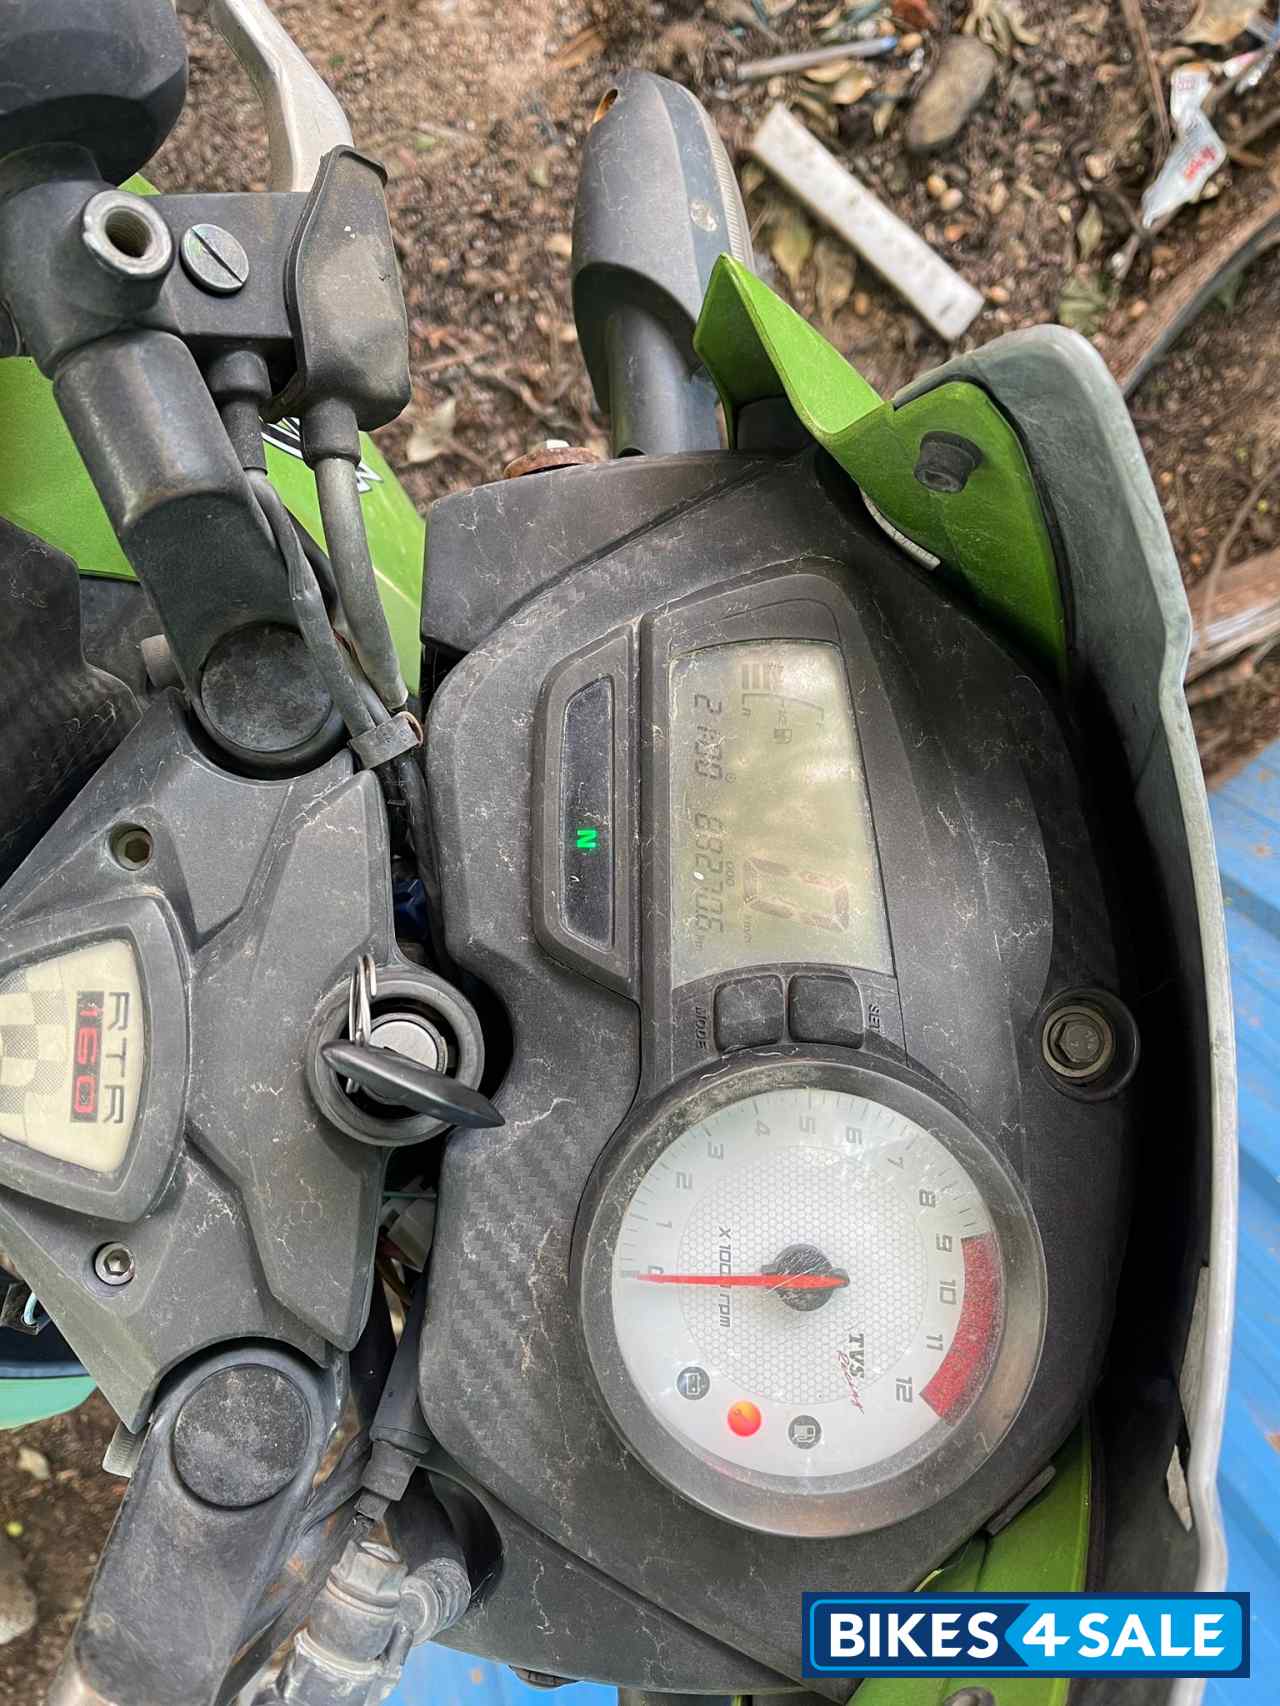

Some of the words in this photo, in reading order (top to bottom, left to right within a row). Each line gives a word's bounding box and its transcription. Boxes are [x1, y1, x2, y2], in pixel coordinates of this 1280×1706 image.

[576, 829, 597, 848] N
[695, 1006, 707, 1049] MODE
[868, 1003, 884, 1034] SET
[74, 1007, 102, 1114] 160
[103, 992, 130, 1124] RTR
[754, 1119, 771, 1137] 4
[800, 1115, 816, 1134] 5
[845, 1125, 863, 1145] 6
[707, 1142, 724, 1160] 3
[887, 1156, 904, 1170] 7
[676, 1171, 693, 1190] 2
[919, 1188, 937, 1208] 8
[656, 1220, 672, 1229] 1
[935, 1233, 953, 1252] 9
[719, 1244, 732, 1288] 100
[939, 1280, 957, 1305] 10
[719, 1294, 731, 1328] rpm
[925, 1334, 943, 1351] 11
[848, 1333, 865, 1379] TVS
[896, 1376, 913, 1403] 12
